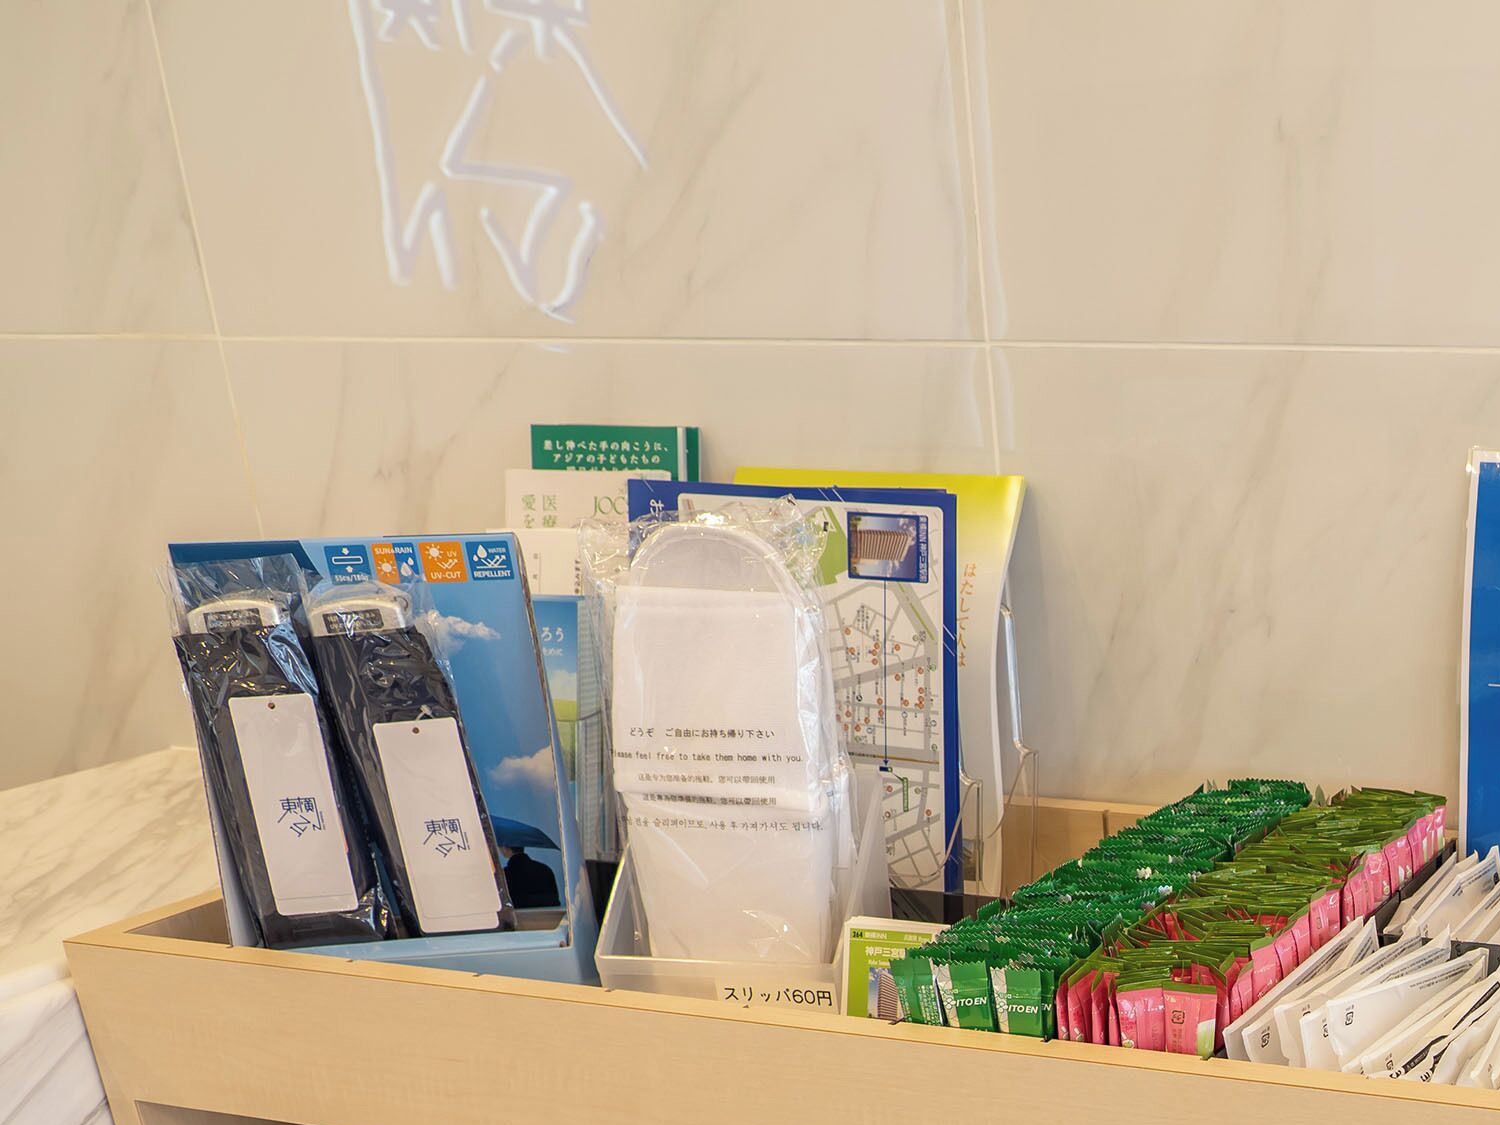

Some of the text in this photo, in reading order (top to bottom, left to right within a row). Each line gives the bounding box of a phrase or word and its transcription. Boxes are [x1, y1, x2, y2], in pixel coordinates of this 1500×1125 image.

[430, 571, 462, 580] UV-CUT
[472, 569, 512, 579] REPELLENT
[665, 727, 776, 739] ご自由にお持ち帰り下さい
[656, 751, 675, 761] free
[679, 752, 688, 762] to
[692, 752, 711, 762] take
[715, 752, 734, 762] them
[737, 753, 757, 763] home
[762, 753, 783, 763] with
[724, 984, 833, 1007] スリッパ60円
